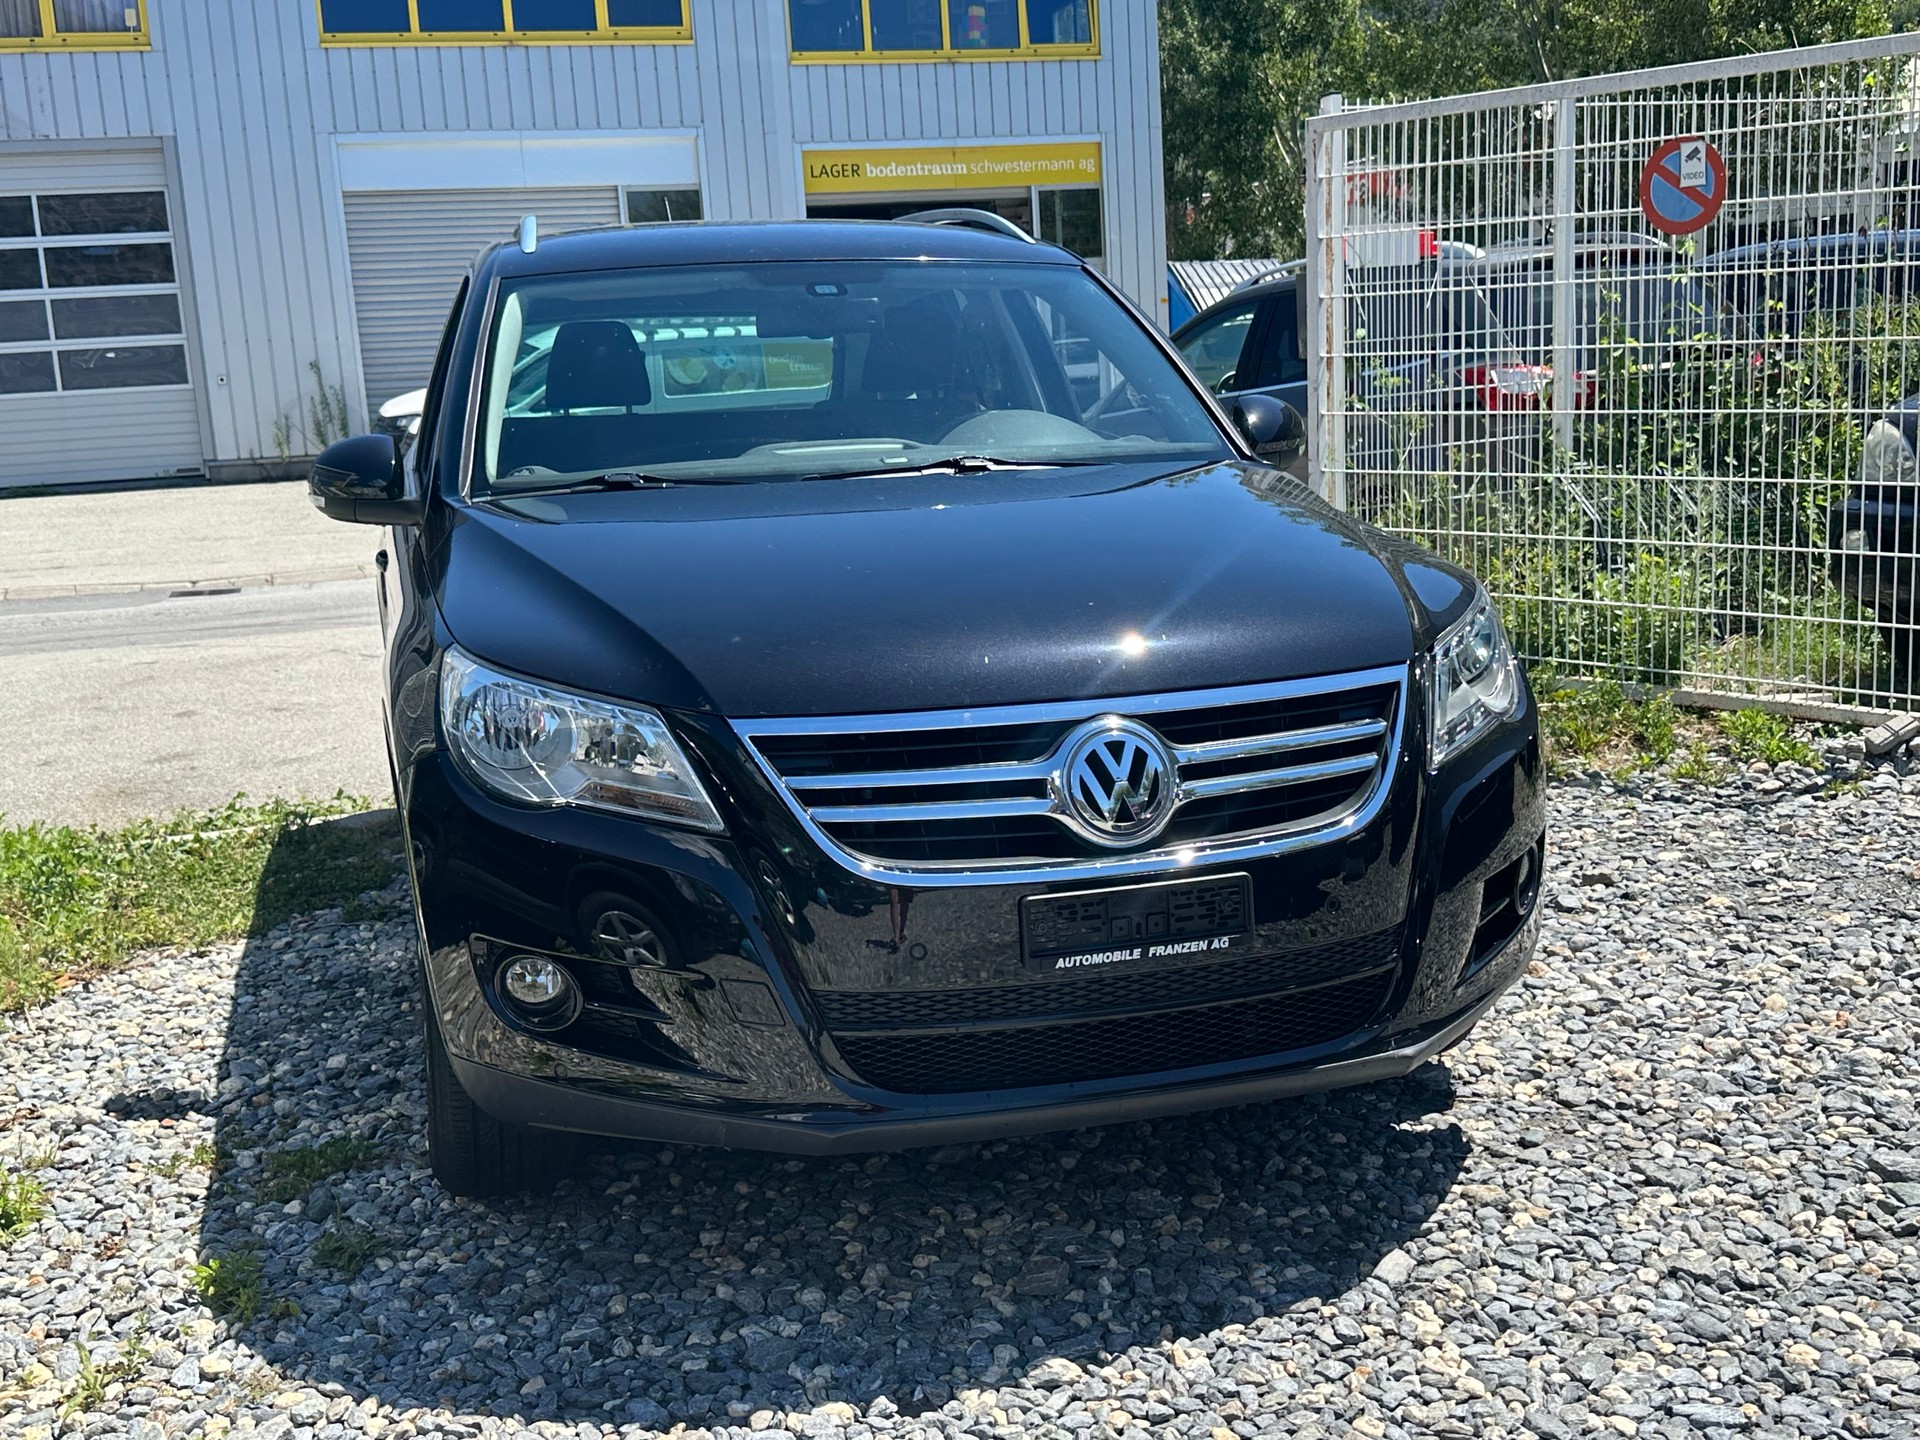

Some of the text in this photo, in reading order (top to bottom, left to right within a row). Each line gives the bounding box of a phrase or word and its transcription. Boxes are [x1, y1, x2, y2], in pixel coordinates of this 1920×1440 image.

[810, 158, 1096, 179] LAGER bodentraum schwestermann ag
[1682, 171, 1704, 181] VIDEO
[1071, 732, 1164, 832] VW
[1055, 937, 1230, 969] AUTOMOBILE FRANZEN AG
